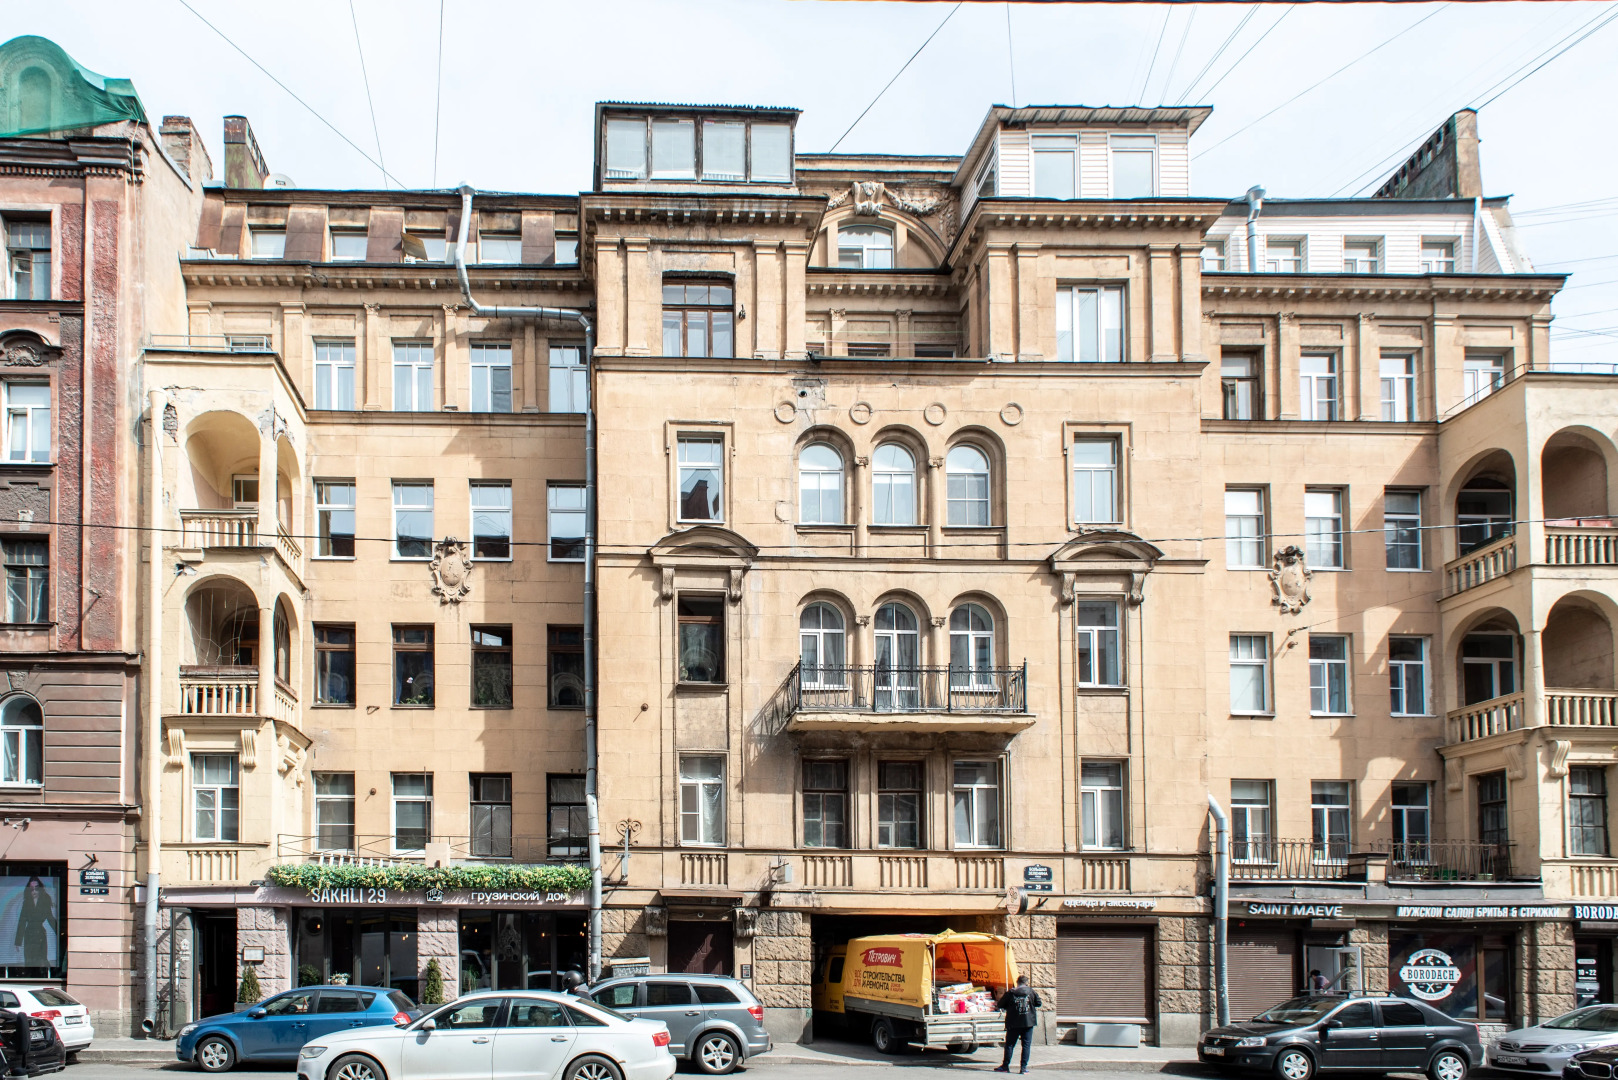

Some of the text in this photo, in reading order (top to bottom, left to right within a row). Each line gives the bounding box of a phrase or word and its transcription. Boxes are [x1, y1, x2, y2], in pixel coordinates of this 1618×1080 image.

[311, 887, 386, 903] SAKHLI 29
[471, 891, 568, 902] грузинский дом
[1064, 900, 1098, 908] одежда
[1107, 900, 1157, 909] аксессуары
[1248, 903, 1343, 916] SAINT MAEVE
[1444, 907, 1475, 918] САЛОН
[1475, 907, 1509, 918] БРИТЬЯ
[1510, 907, 1518, 918] &
[1519, 907, 1560, 918] СТРИЖКИ
[868, 950, 897, 964] ПЕТРОВИЧ
[862, 970, 906, 983] СТРОИТЕЛЬСТВА
[1407, 969, 1454, 980] BORODACH
[867, 980, 889, 991] РЕМОНТА
